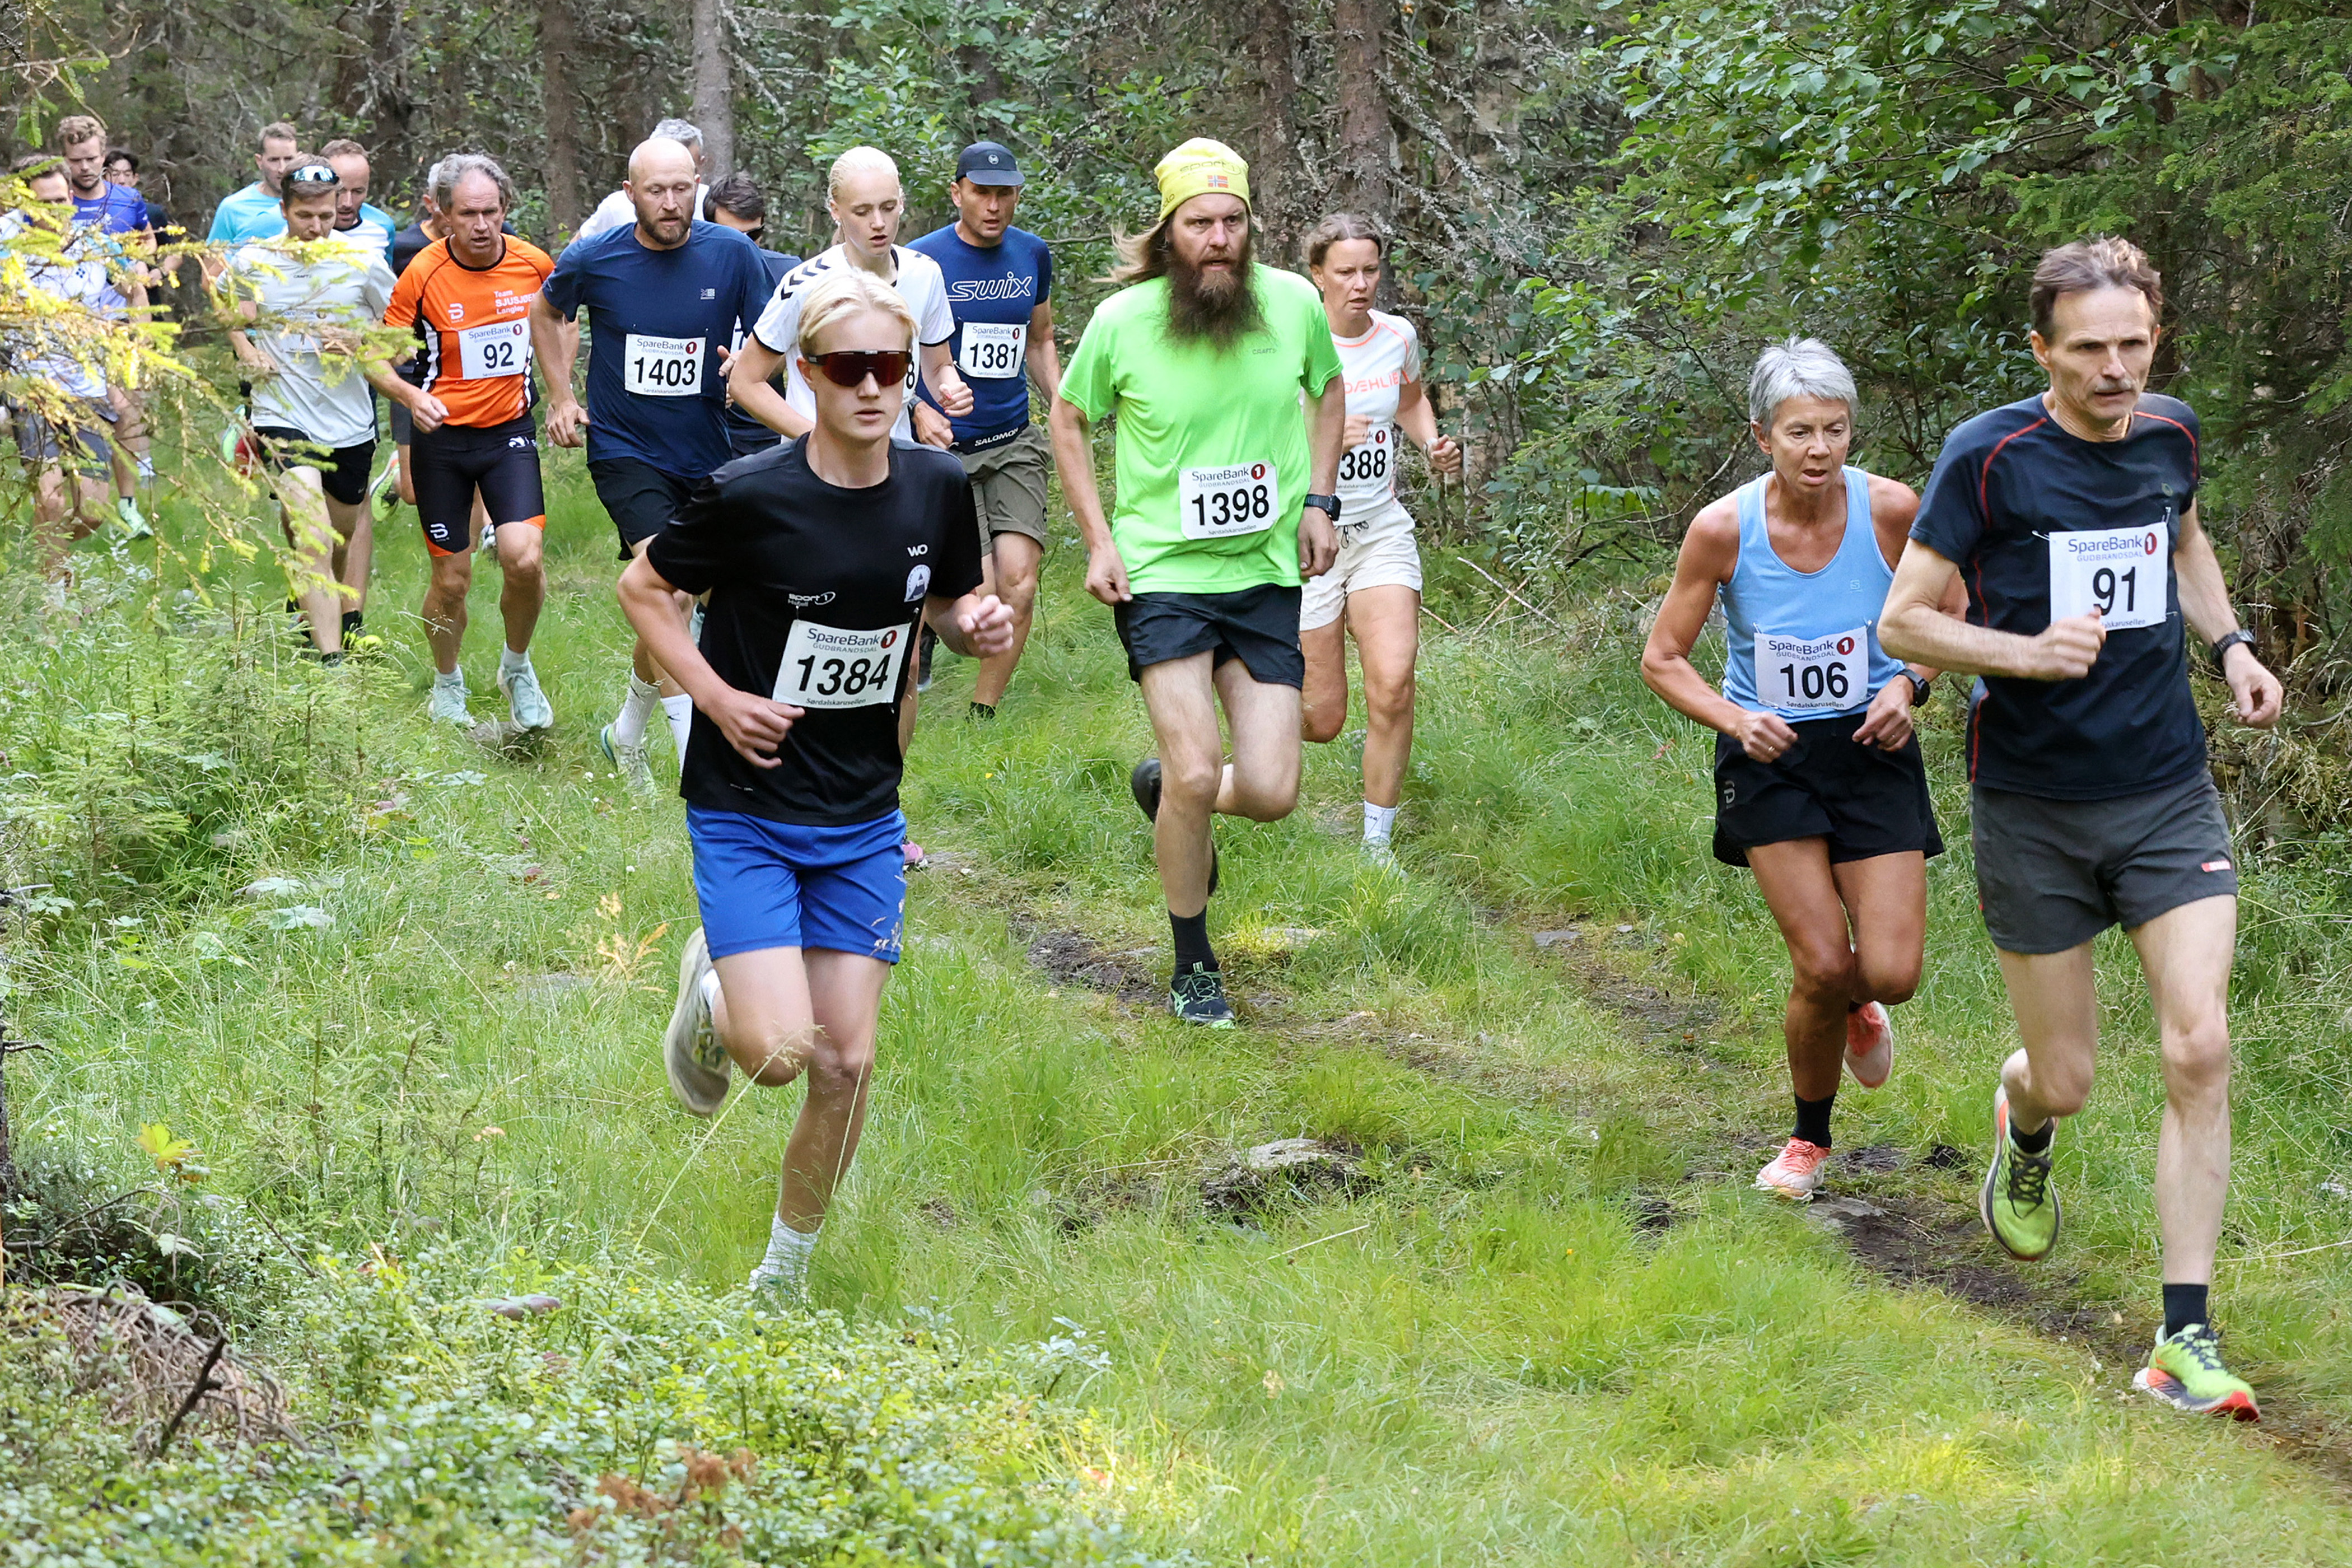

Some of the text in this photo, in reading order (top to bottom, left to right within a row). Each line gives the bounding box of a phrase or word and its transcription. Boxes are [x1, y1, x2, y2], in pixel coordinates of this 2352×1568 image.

[469, 326, 511, 339] SpareBank
[973, 326, 1011, 334] SpareBank
[637, 338, 684, 350] SpareBank
[483, 342, 514, 369] 92
[970, 343, 1018, 369] 1381
[634, 357, 696, 386] 1403
[975, 427, 1018, 446] SALOMON
[1192, 467, 1249, 482] SpareBank
[1192, 484, 1269, 525] 1398
[2069, 535, 2143, 553] SpareBank
[2077, 551, 2143, 562] GUDBRANDSDAL
[2093, 566, 2135, 616] 91
[807, 628, 880, 646] SpareBank
[813, 643, 878, 652] GUDBRANDSDAL
[1768, 640, 1834, 655] SpareBank
[1776, 651, 1836, 661] GUDBRANDSDAL
[797, 654, 891, 696] 1384
[1780, 662, 1849, 699] 106
